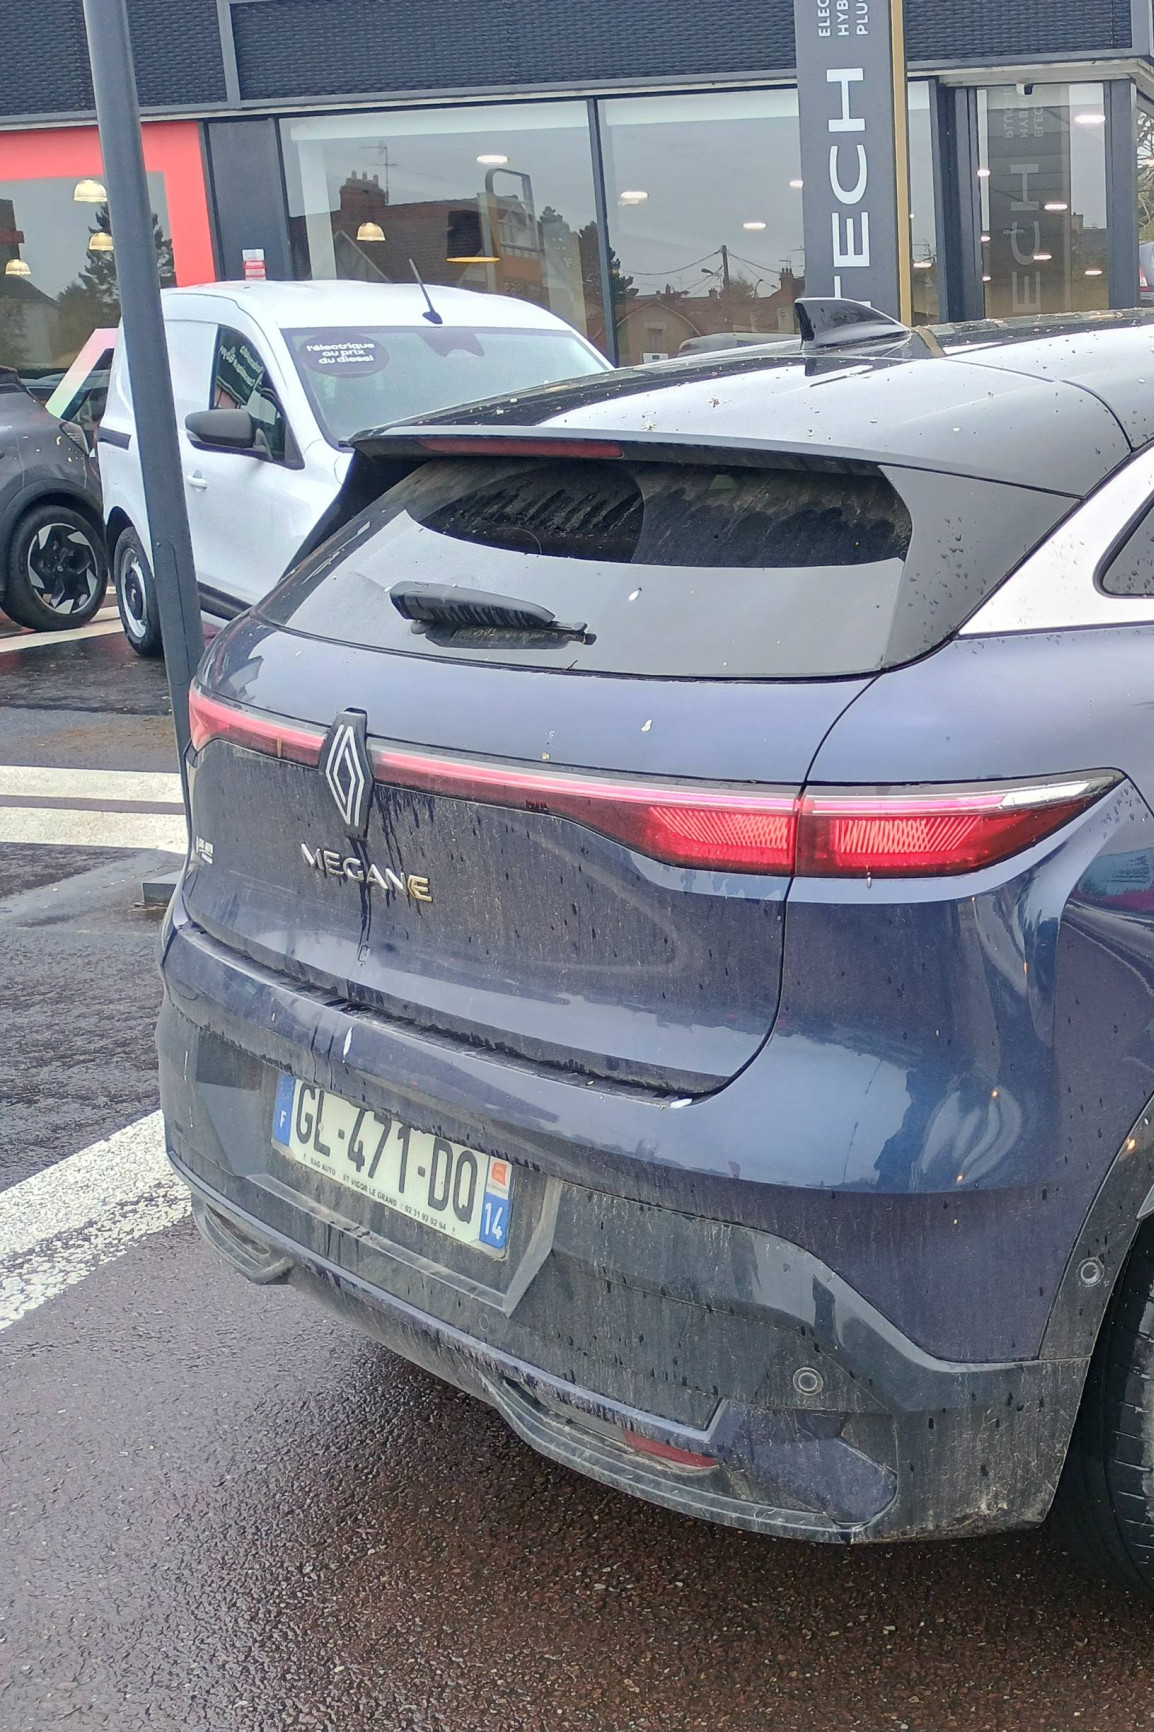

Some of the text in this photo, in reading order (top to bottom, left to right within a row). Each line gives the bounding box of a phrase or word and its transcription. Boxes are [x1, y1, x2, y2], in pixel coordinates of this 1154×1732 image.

[856, 0, 869, 35] PLU
[337, 355, 375, 363] diesel
[341, 349, 366, 357] prix
[279, 1110, 287, 1128] F
[295, 1082, 479, 1224] GL-471-DQ
[351, 1178, 368, 1192] VIGOR
[369, 1187, 376, 1196] LE
[377, 1192, 397, 1206] GRAND
[404, 1203, 412, 1213] 02
[412, 1207, 421, 1218] 31
[484, 1202, 505, 1240] 14
